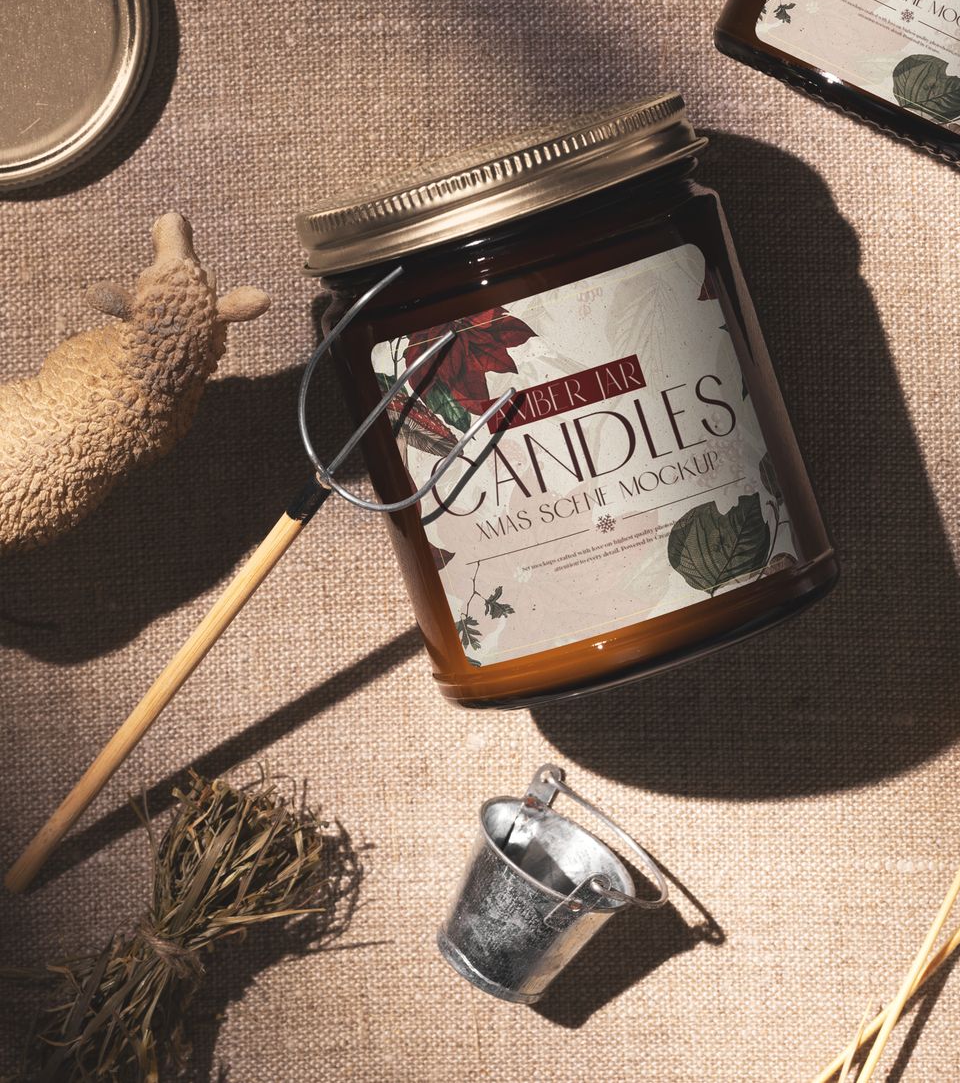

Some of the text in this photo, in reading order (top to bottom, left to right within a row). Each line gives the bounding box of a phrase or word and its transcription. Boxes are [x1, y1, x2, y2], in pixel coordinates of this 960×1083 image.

[495, 361, 642, 427] AMBER JAR
[431, 375, 737, 517] CANDLES
[475, 450, 720, 541] XMAS SCENE MOCKUP
[620, 539, 646, 552] Powered
